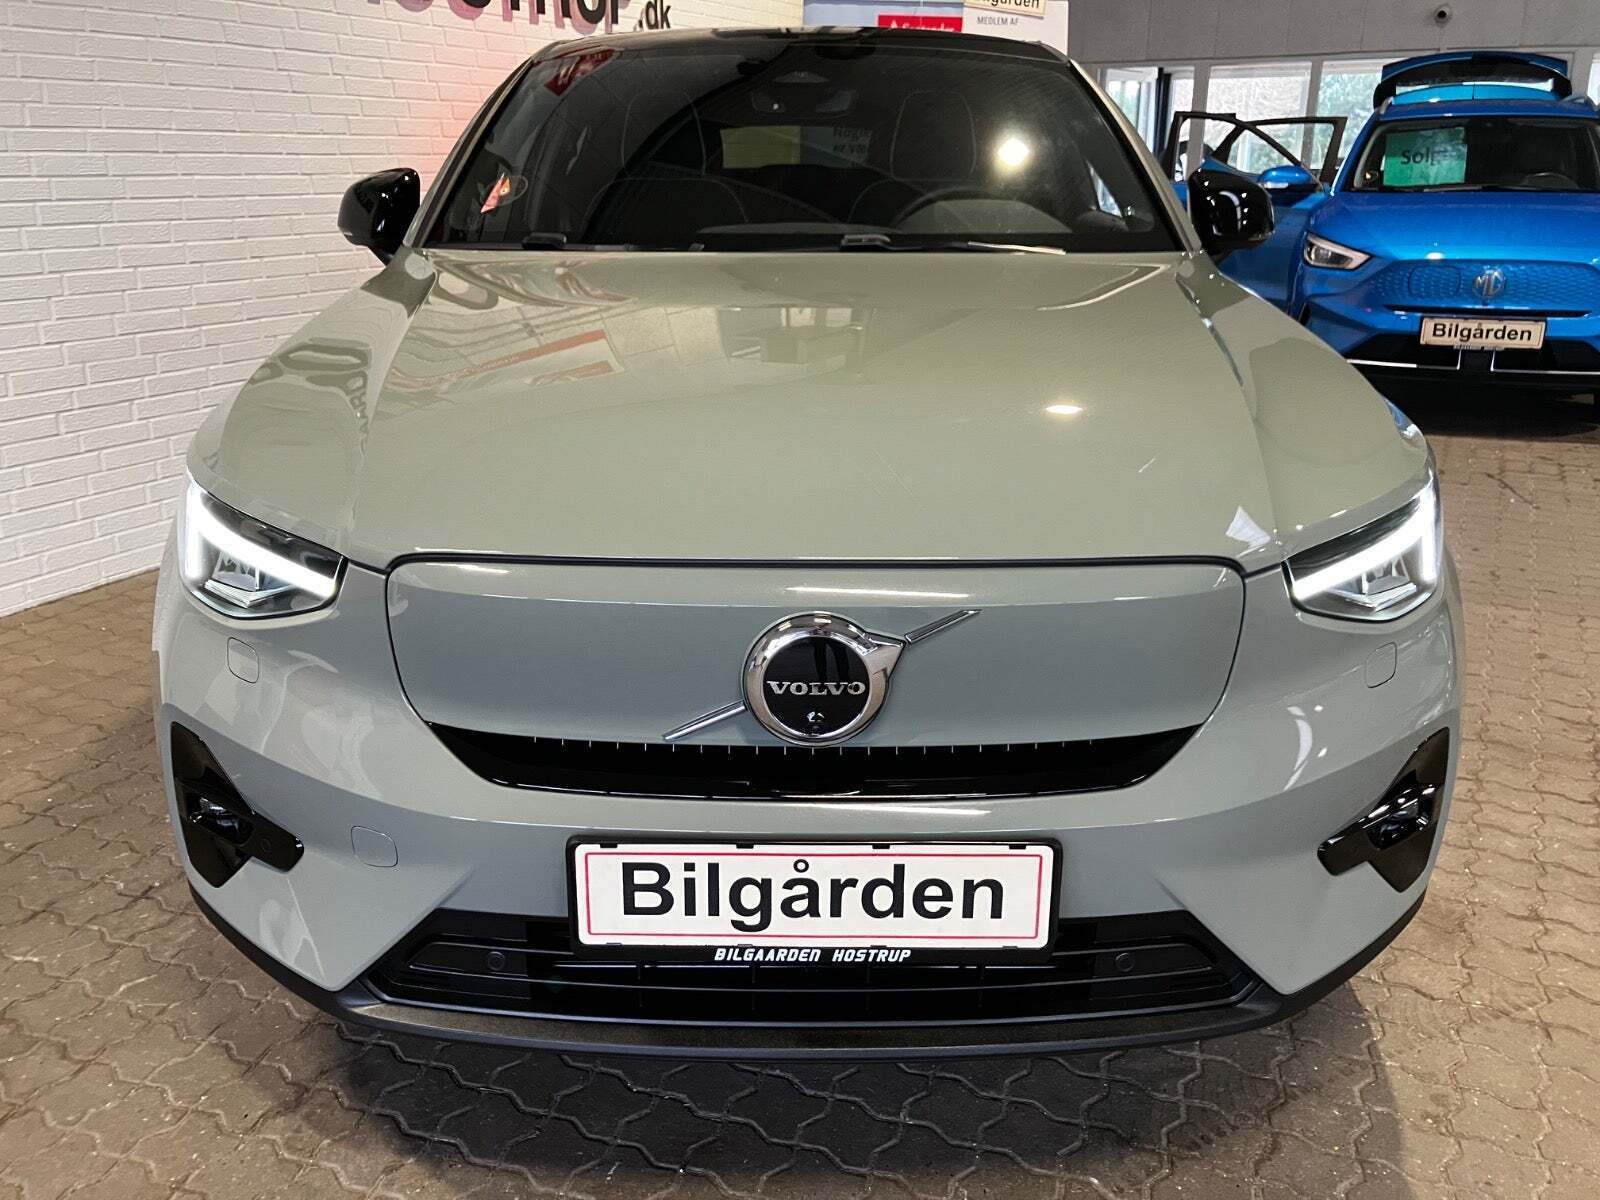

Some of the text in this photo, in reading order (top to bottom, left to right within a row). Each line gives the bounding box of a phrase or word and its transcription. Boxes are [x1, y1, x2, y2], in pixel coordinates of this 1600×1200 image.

[976, 16, 1008, 25] MEDLEM
[1432, 322, 1532, 342] Bilgården
[766, 681, 865, 695] VOLVO
[622, 858, 1003, 932] Bilgården
[714, 948, 912, 964] BILGAARDEN HOSTRUP
